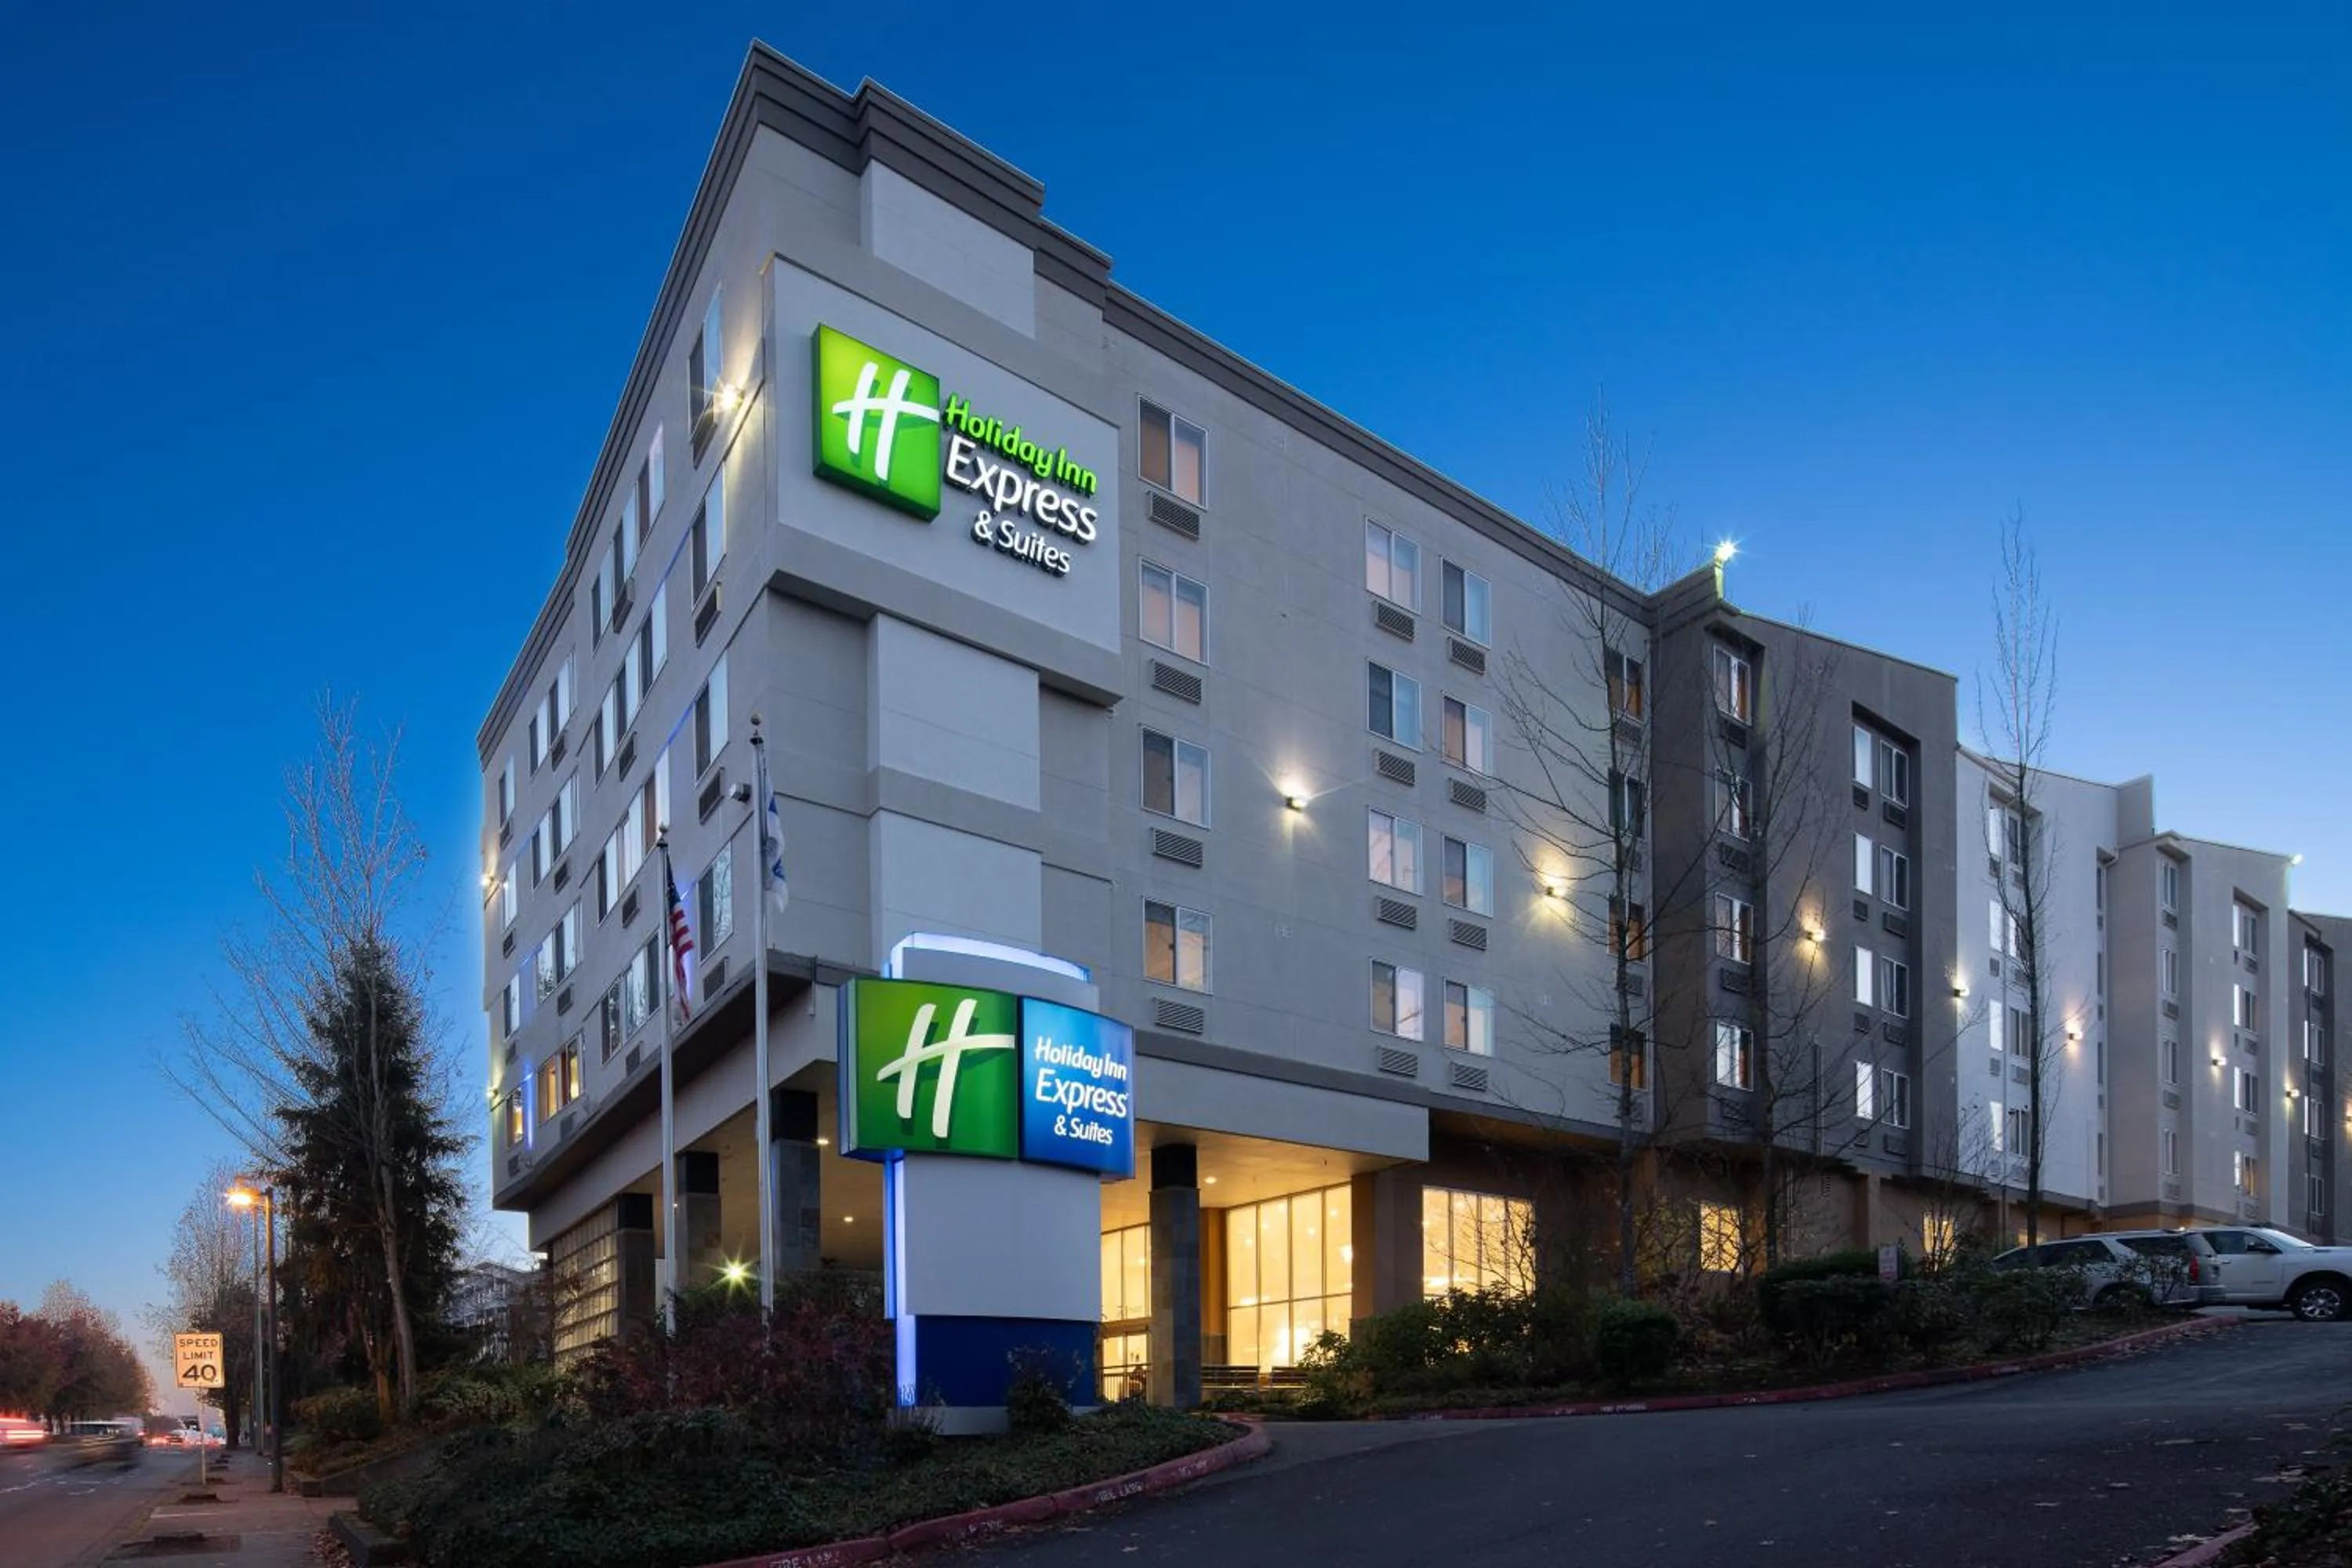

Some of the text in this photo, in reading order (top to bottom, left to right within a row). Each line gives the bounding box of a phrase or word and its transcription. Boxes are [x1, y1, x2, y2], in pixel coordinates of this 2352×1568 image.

[946, 394, 1098, 494] Holiday Inn
[946, 434, 1098, 541] Express
[975, 510, 1070, 574] & Suites
[1035, 1036, 1127, 1081] Holiday Inn
[1036, 1067, 1127, 1118] Express
[1054, 1114, 1114, 1145] & Suites
[179, 1338, 218, 1348] SPEED
[183, 1351, 214, 1360] LIMIT
[181, 1364, 217, 1382] 40
